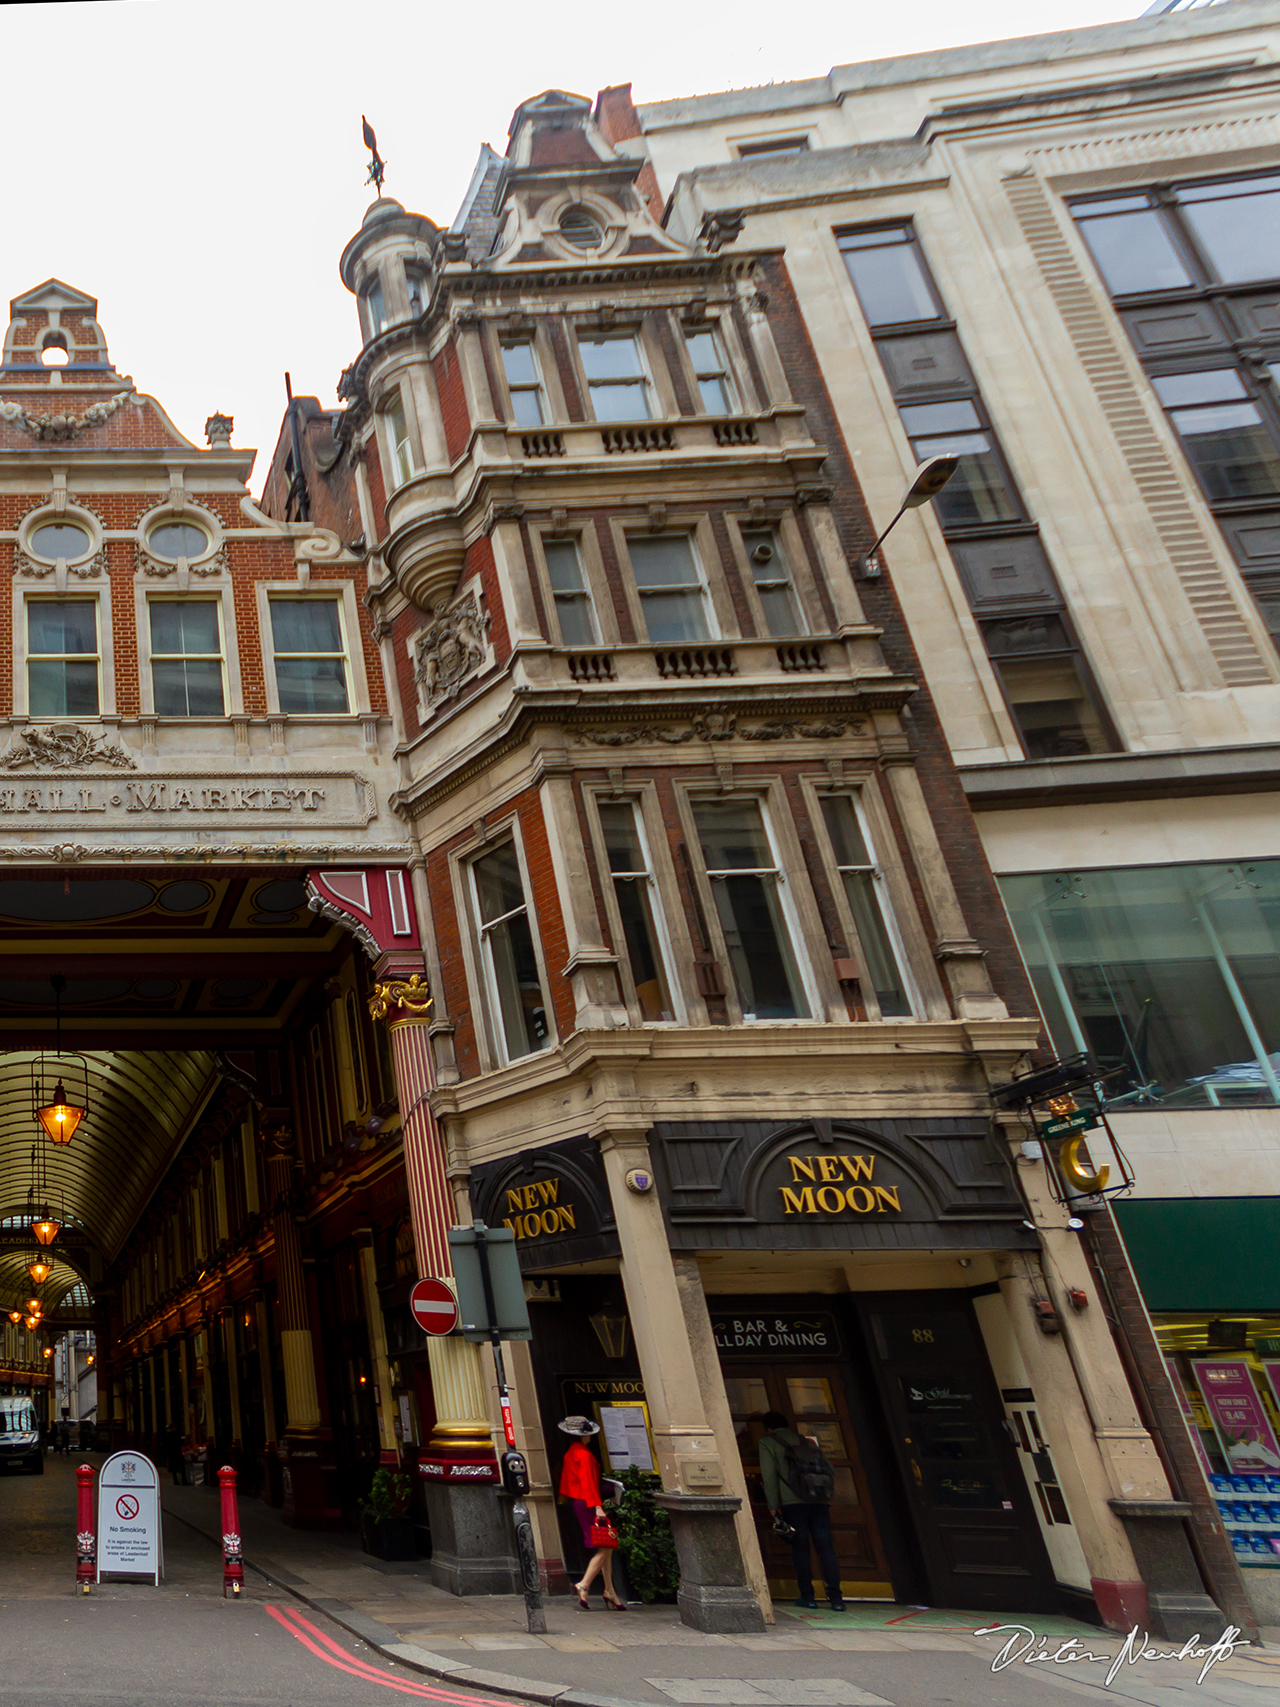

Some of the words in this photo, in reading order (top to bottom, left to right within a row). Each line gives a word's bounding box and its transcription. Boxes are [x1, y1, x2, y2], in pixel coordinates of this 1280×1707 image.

[126, 782, 326, 812] MARKET
[1048, 1121, 1071, 1133] GREENE
[1071, 1117, 1086, 1127] KING
[787, 1155, 875, 1182] NEW
[505, 1177, 559, 1213] NEW
[778, 1185, 902, 1214] MOON
[501, 1203, 577, 1240] MOON
[733, 1320, 768, 1333] BAR
[775, 1320, 788, 1332] &
[715, 1334, 763, 1347] LLDAY
[767, 1332, 828, 1346] DINING
[911, 1328, 935, 1343] 88
[574, 1382, 609, 1393] NEW
[611, 1382, 645, 1394] MOO
[120, 1526, 147, 1534] Smoking
